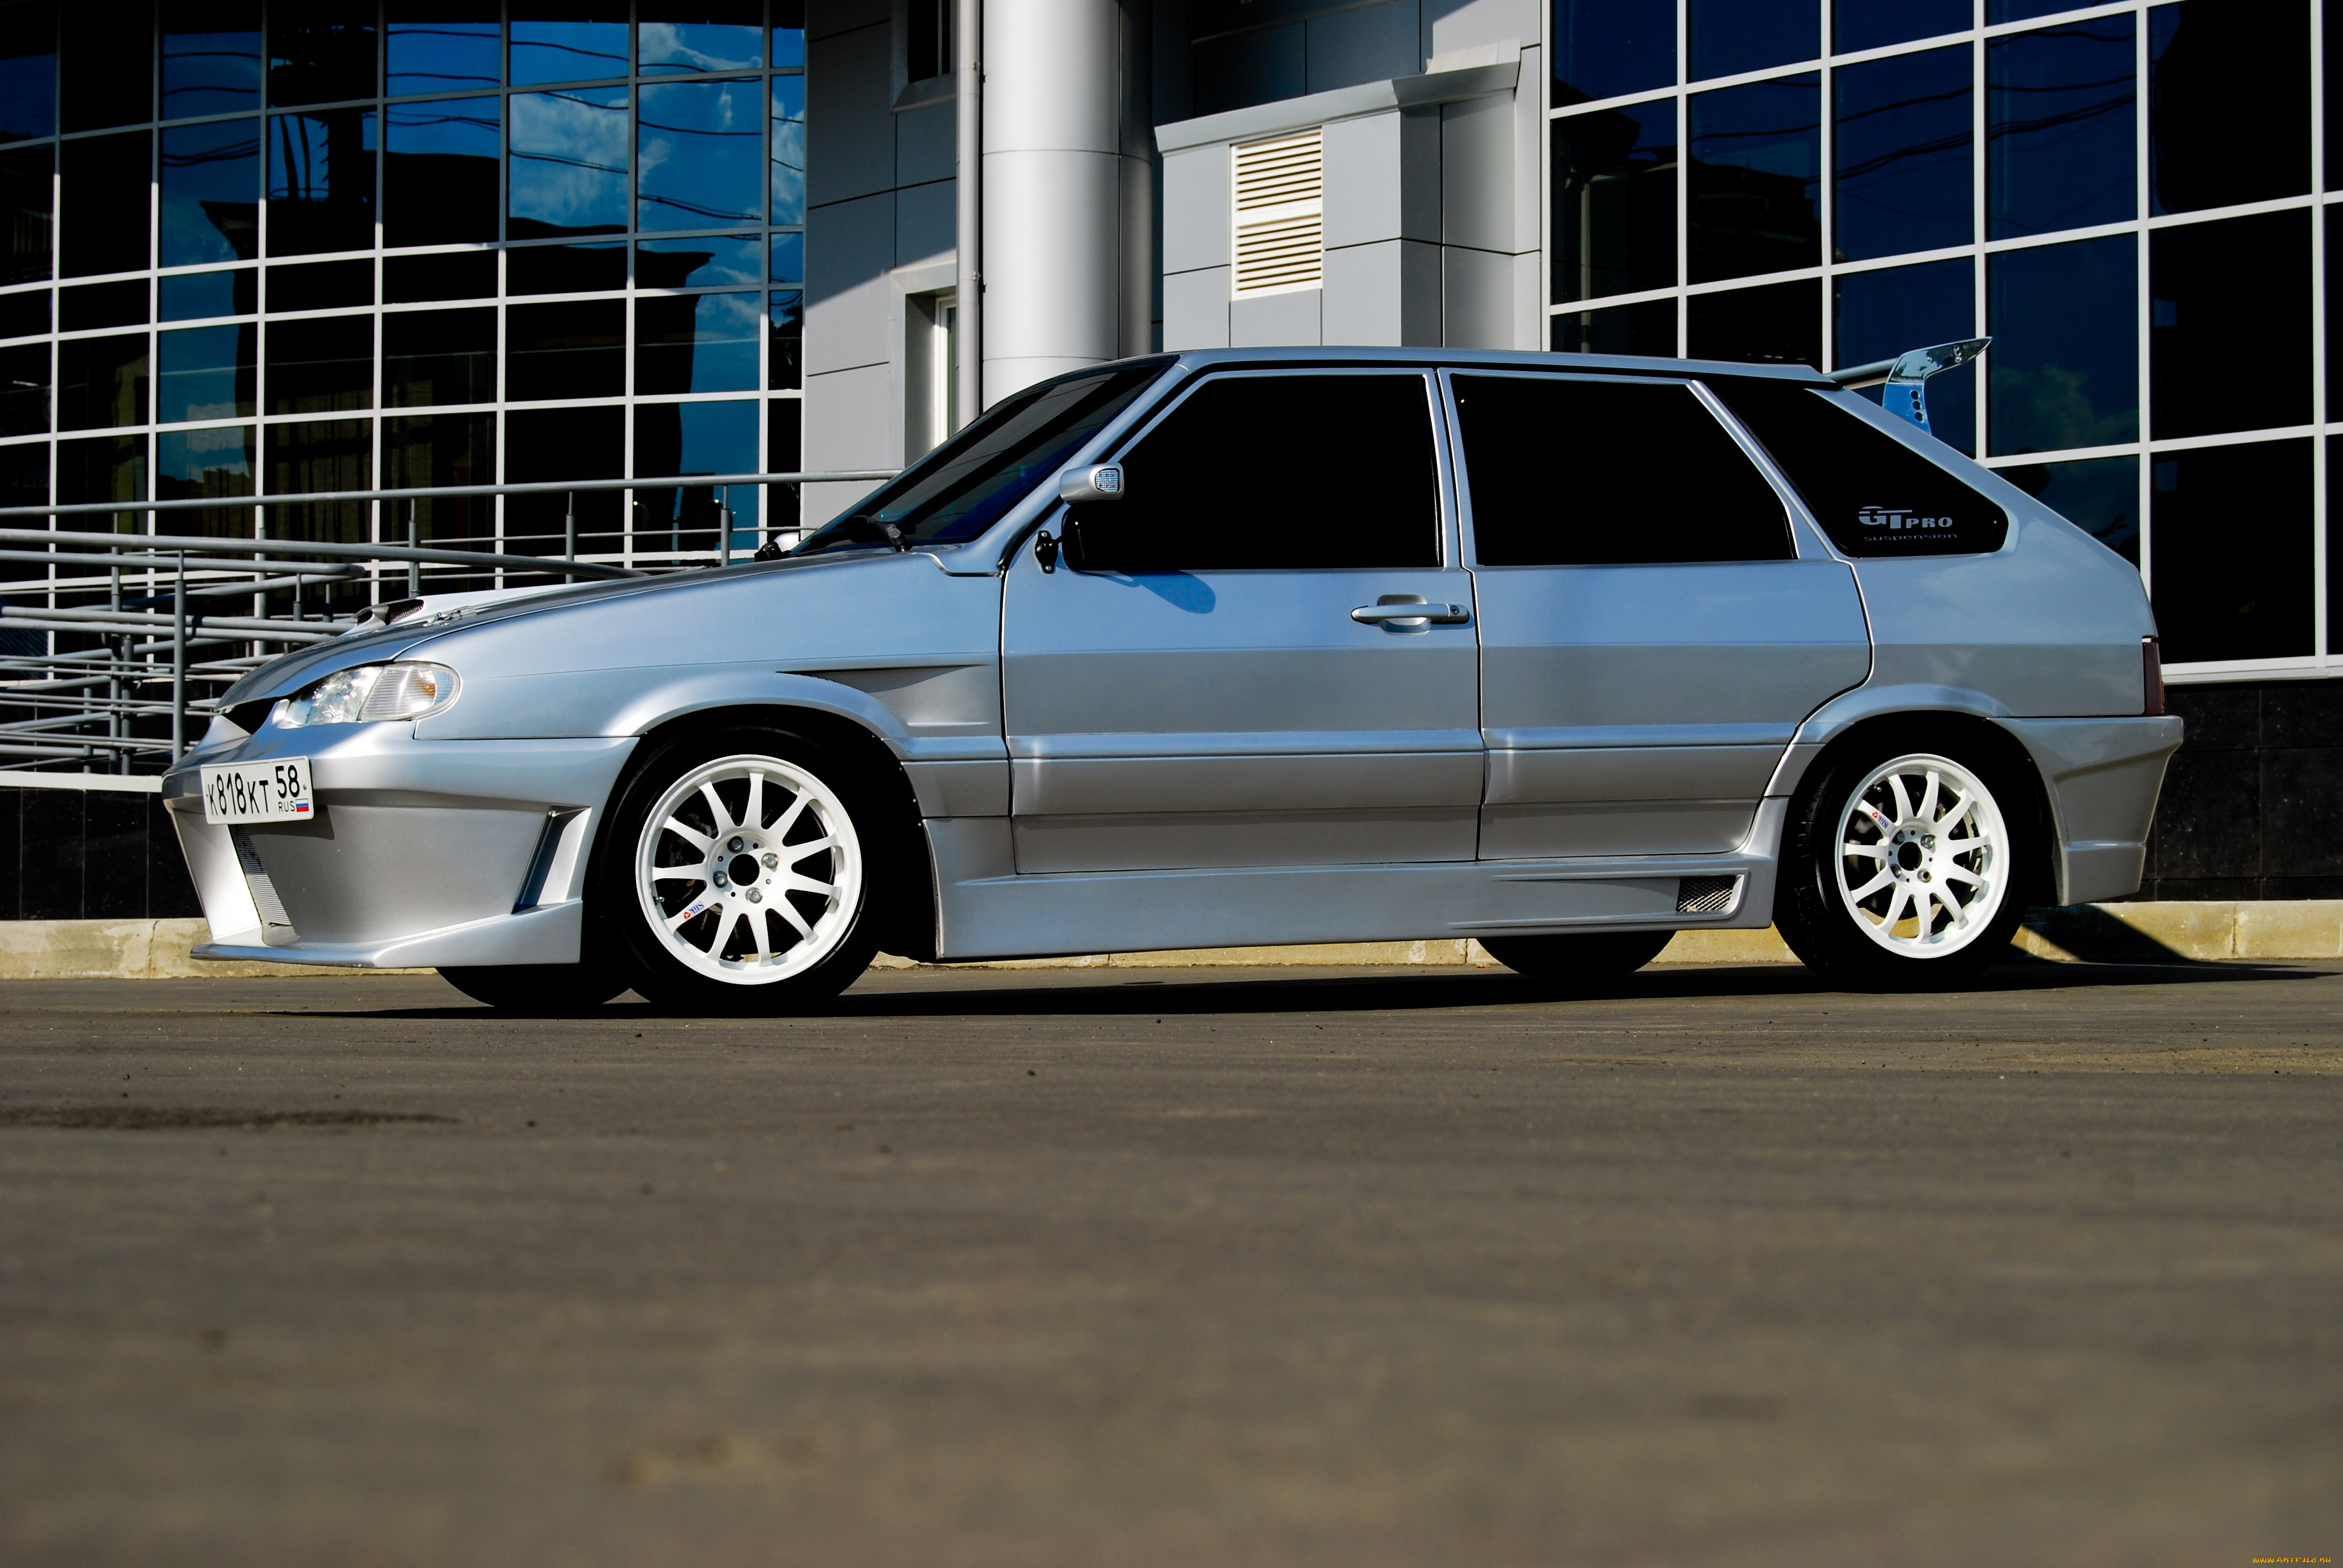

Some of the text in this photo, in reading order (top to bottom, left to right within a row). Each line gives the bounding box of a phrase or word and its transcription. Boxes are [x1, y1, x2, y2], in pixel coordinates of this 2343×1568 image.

[1858, 506, 1953, 529] GT PRO
[275, 765, 300, 799] 58
[278, 800, 295, 812] RUS
